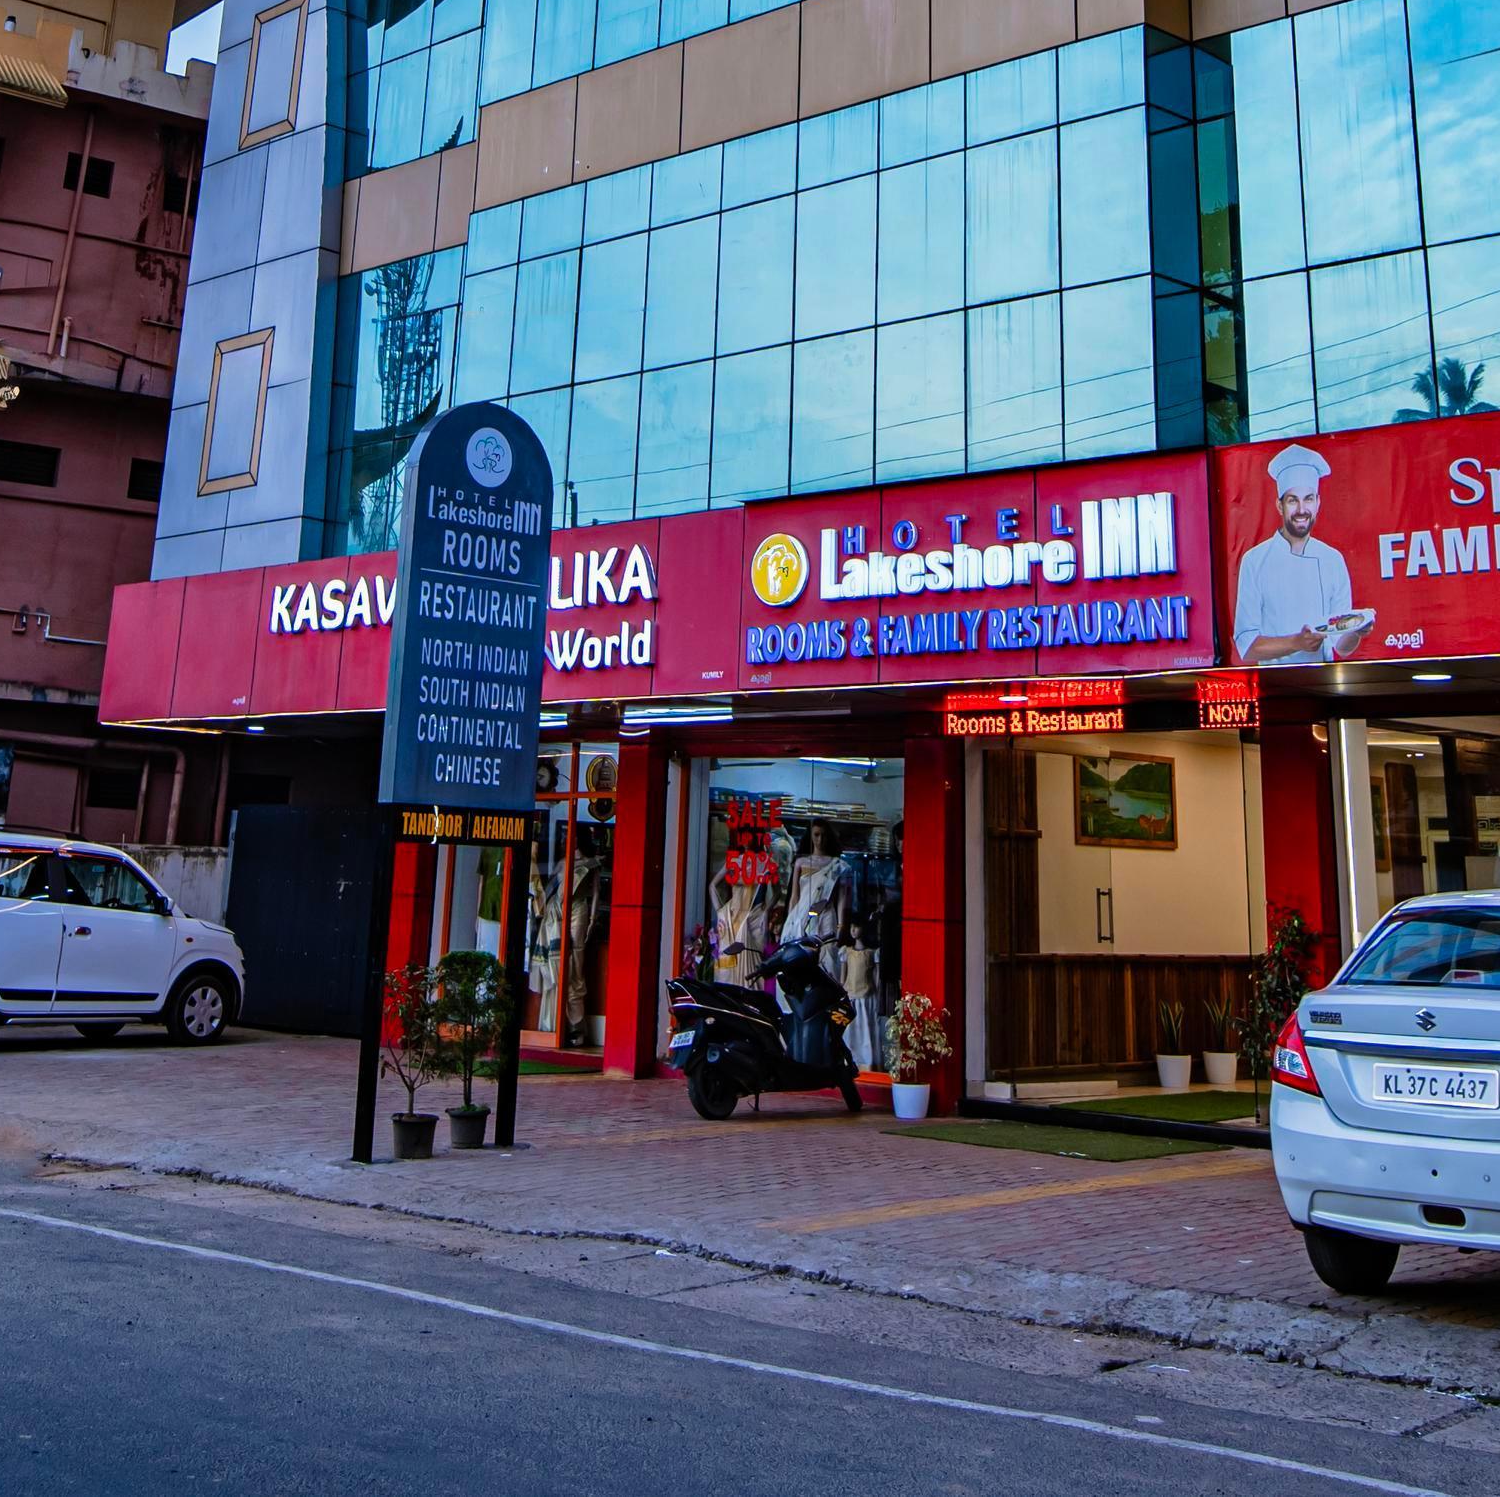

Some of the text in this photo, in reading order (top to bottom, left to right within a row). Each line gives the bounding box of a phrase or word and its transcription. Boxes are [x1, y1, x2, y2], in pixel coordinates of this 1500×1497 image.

[428, 485, 542, 535] Lakeshore INN
[437, 487, 511, 509] HOTEL
[820, 492, 1176, 601] Lakeshore INN
[842, 504, 1074, 555] HOTEL
[443, 529, 520, 575] ROOMS
[269, 544, 657, 634] KASAV LIKA
[419, 580, 537, 630] RESTAURANT
[545, 619, 654, 671] World
[746, 595, 1191, 664] ROOMS & FAMILY RESTAURANT
[421, 637, 528, 676] NORTH INDIAN
[419, 675, 526, 712] SOUTH INDIAN
[417, 713, 522, 750] CONTINENTAL
[947, 708, 1124, 735] Rooms & Restaurant
[1208, 704, 1249, 723] NOW
[435, 753, 501, 786] CHINESE
[402, 811, 524, 841] TANDOOR ALFAHAM
[726, 799, 783, 829] SALE
[725, 850, 778, 886] 50%
[1384, 1074, 1488, 1100] KL 37 C 4437
